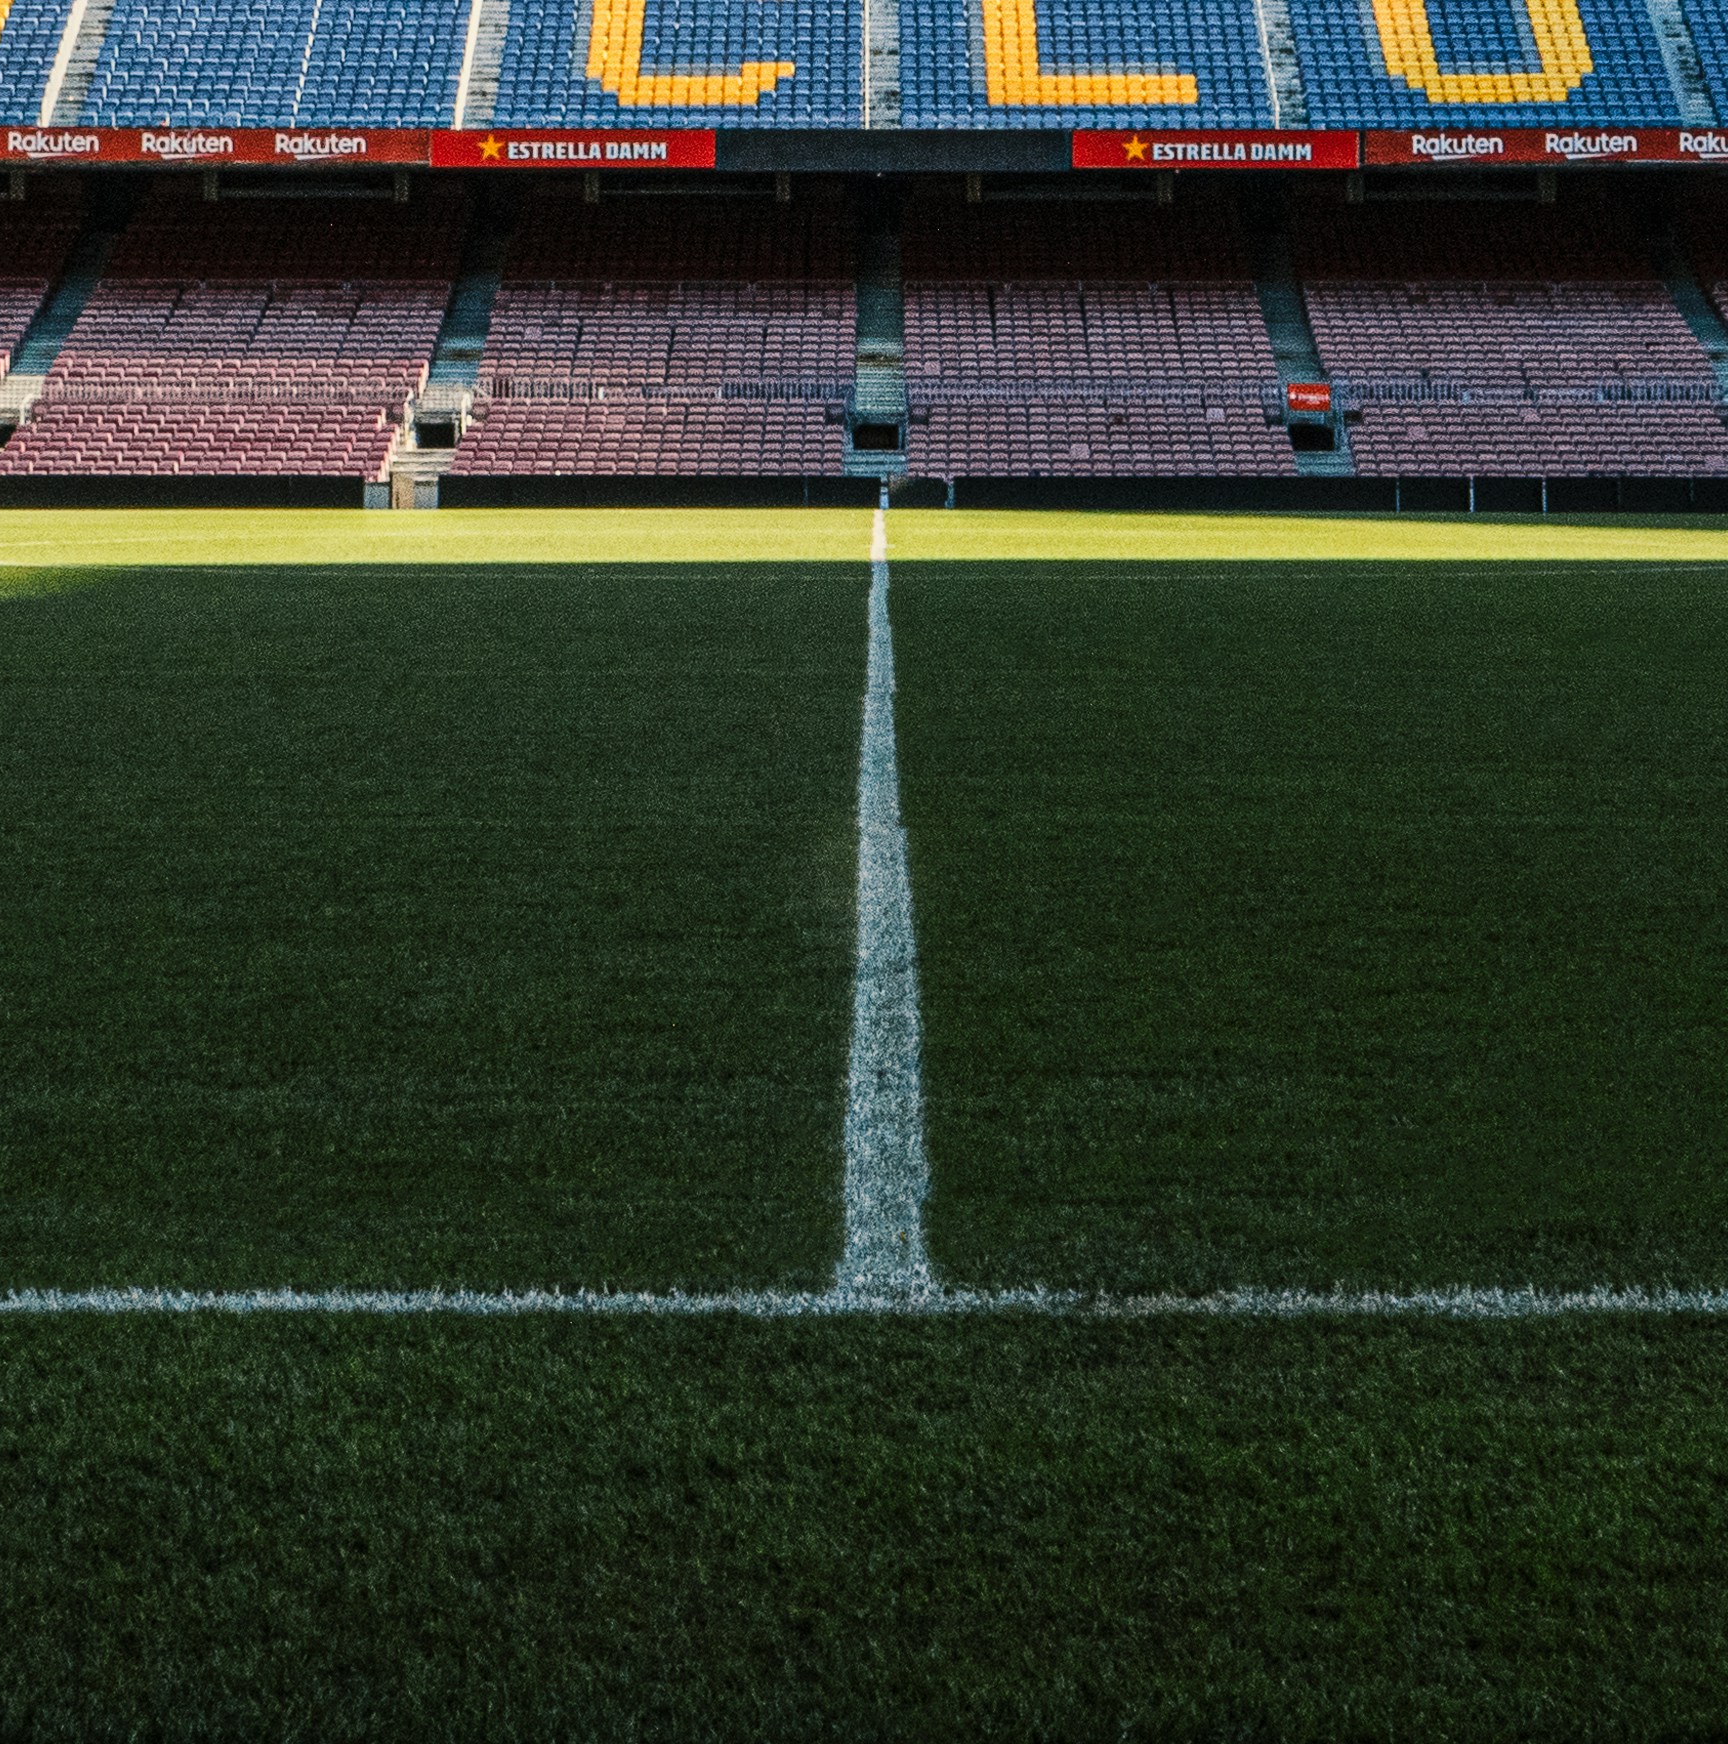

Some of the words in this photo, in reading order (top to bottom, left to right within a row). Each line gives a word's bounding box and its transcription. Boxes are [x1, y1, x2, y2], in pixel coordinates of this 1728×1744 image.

[8, 132, 99, 152] Rakuten
[142, 133, 232, 153] Rakuten
[276, 134, 366, 154] Rakuten
[508, 142, 602, 160] ESTRELLA
[605, 142, 667, 160] DAMM
[1153, 143, 1246, 160] ESTRELLA
[1251, 143, 1312, 161] DAMM
[1412, 135, 1503, 155] Rakuten
[1546, 134, 1637, 154] Rakuten
